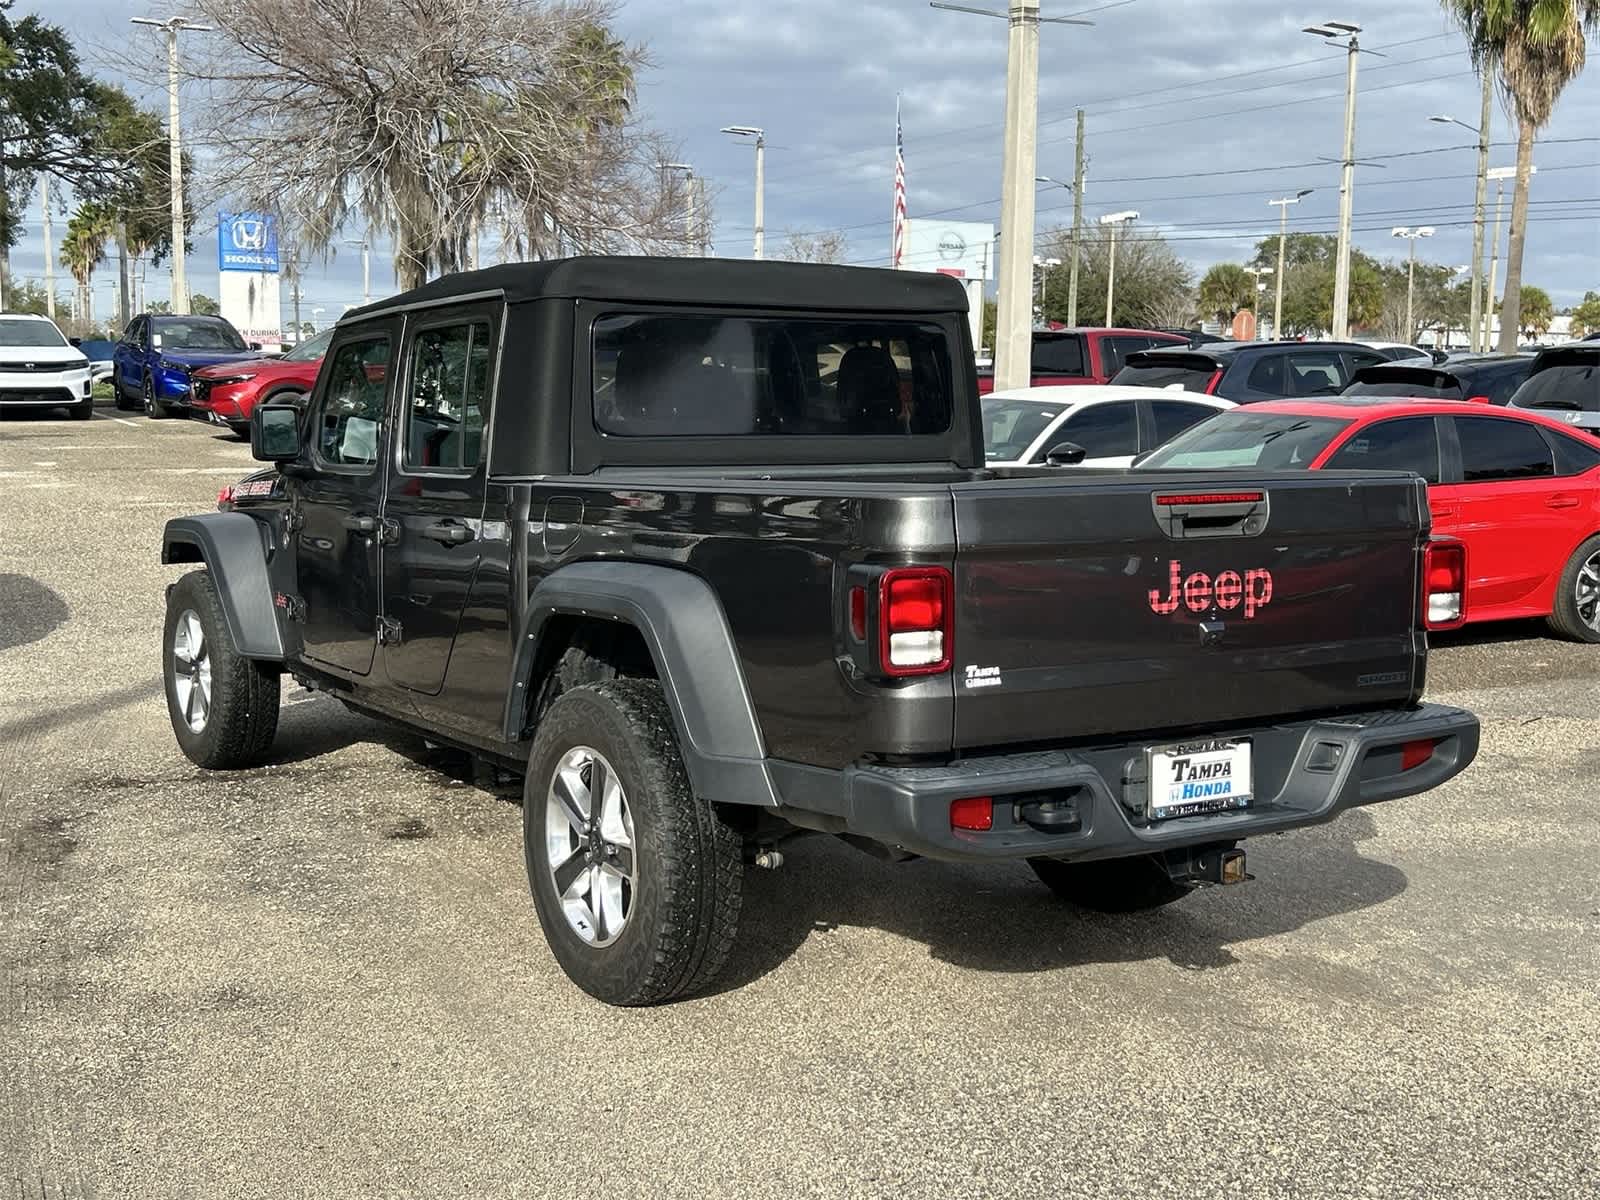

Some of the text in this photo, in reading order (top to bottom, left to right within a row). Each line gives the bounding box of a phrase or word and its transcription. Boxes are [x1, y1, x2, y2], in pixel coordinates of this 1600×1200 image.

[250, 329, 279, 337] DURING
[1148, 559, 1273, 619] Jeep
[1171, 758, 1232, 782] TAMPA
[1182, 780, 1232, 799] HONDA
